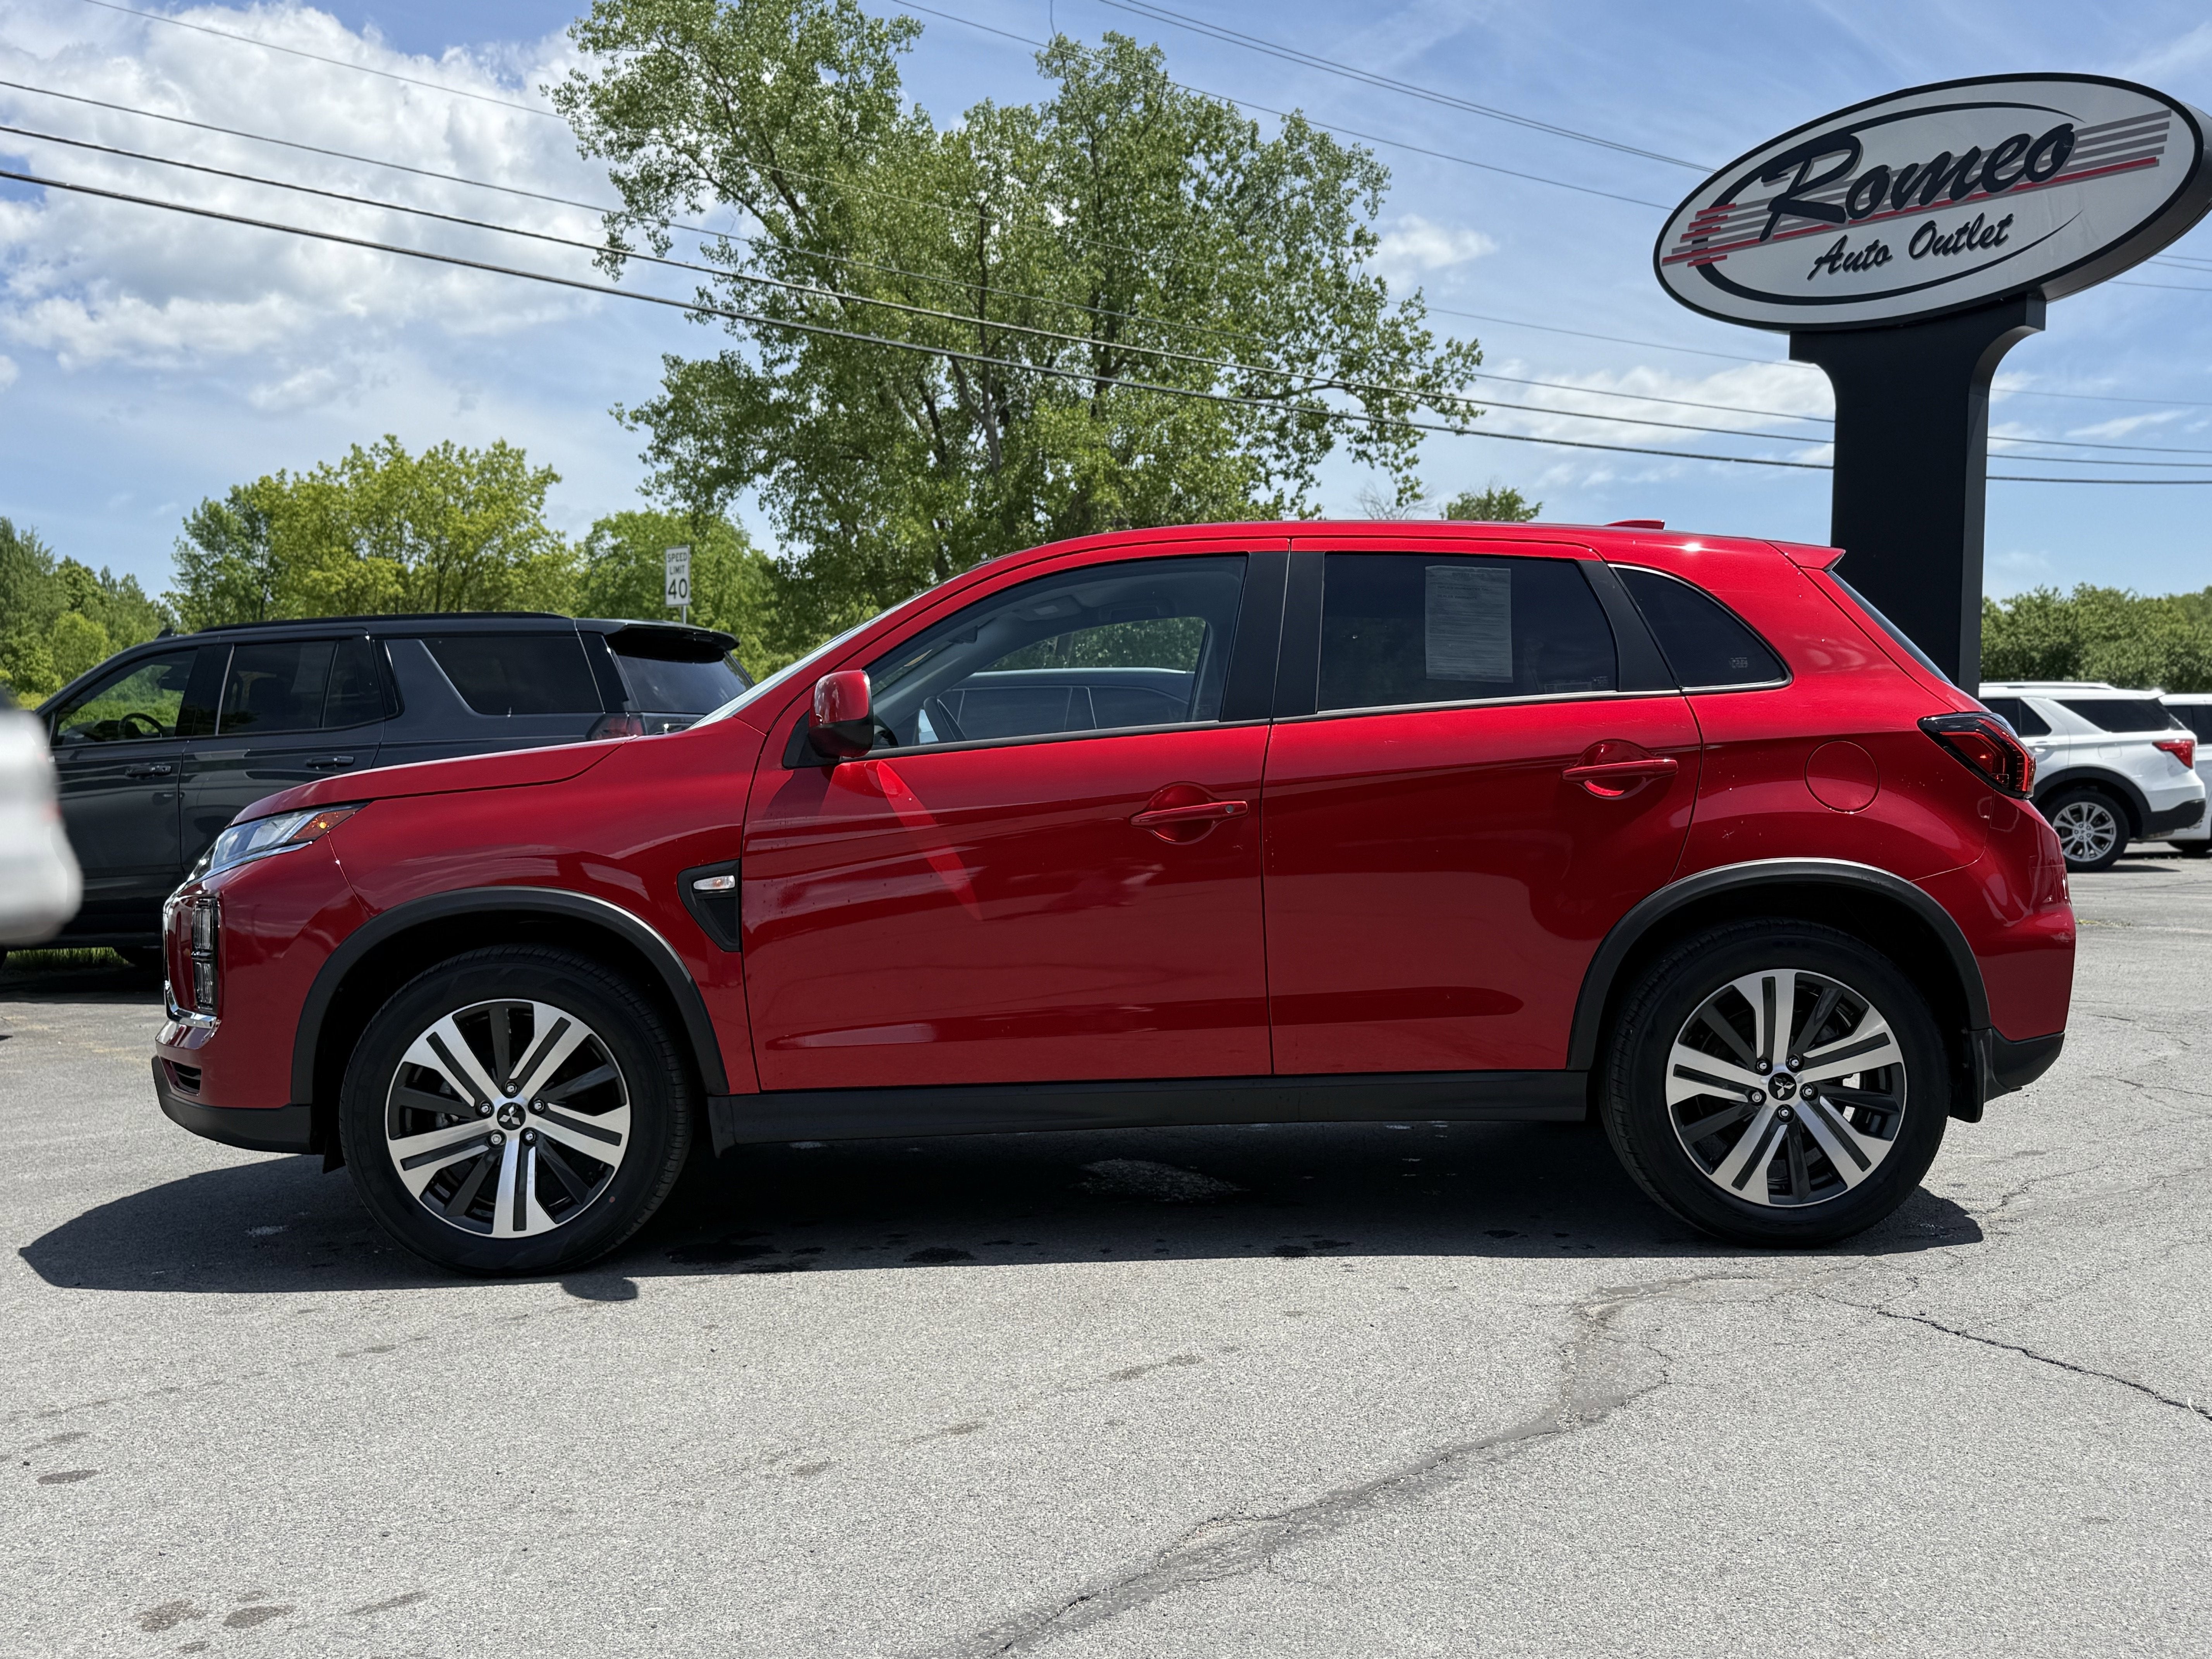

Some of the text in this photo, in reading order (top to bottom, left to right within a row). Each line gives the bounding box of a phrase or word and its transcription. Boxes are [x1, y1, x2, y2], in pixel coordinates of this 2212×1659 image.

[1758, 123, 2075, 242] Romeo
[1807, 212, 2013, 281] Auto Outlet
[668, 552, 687, 562] SPEED
[670, 565, 685, 575] LIMIT
[668, 578, 687, 599] 40
